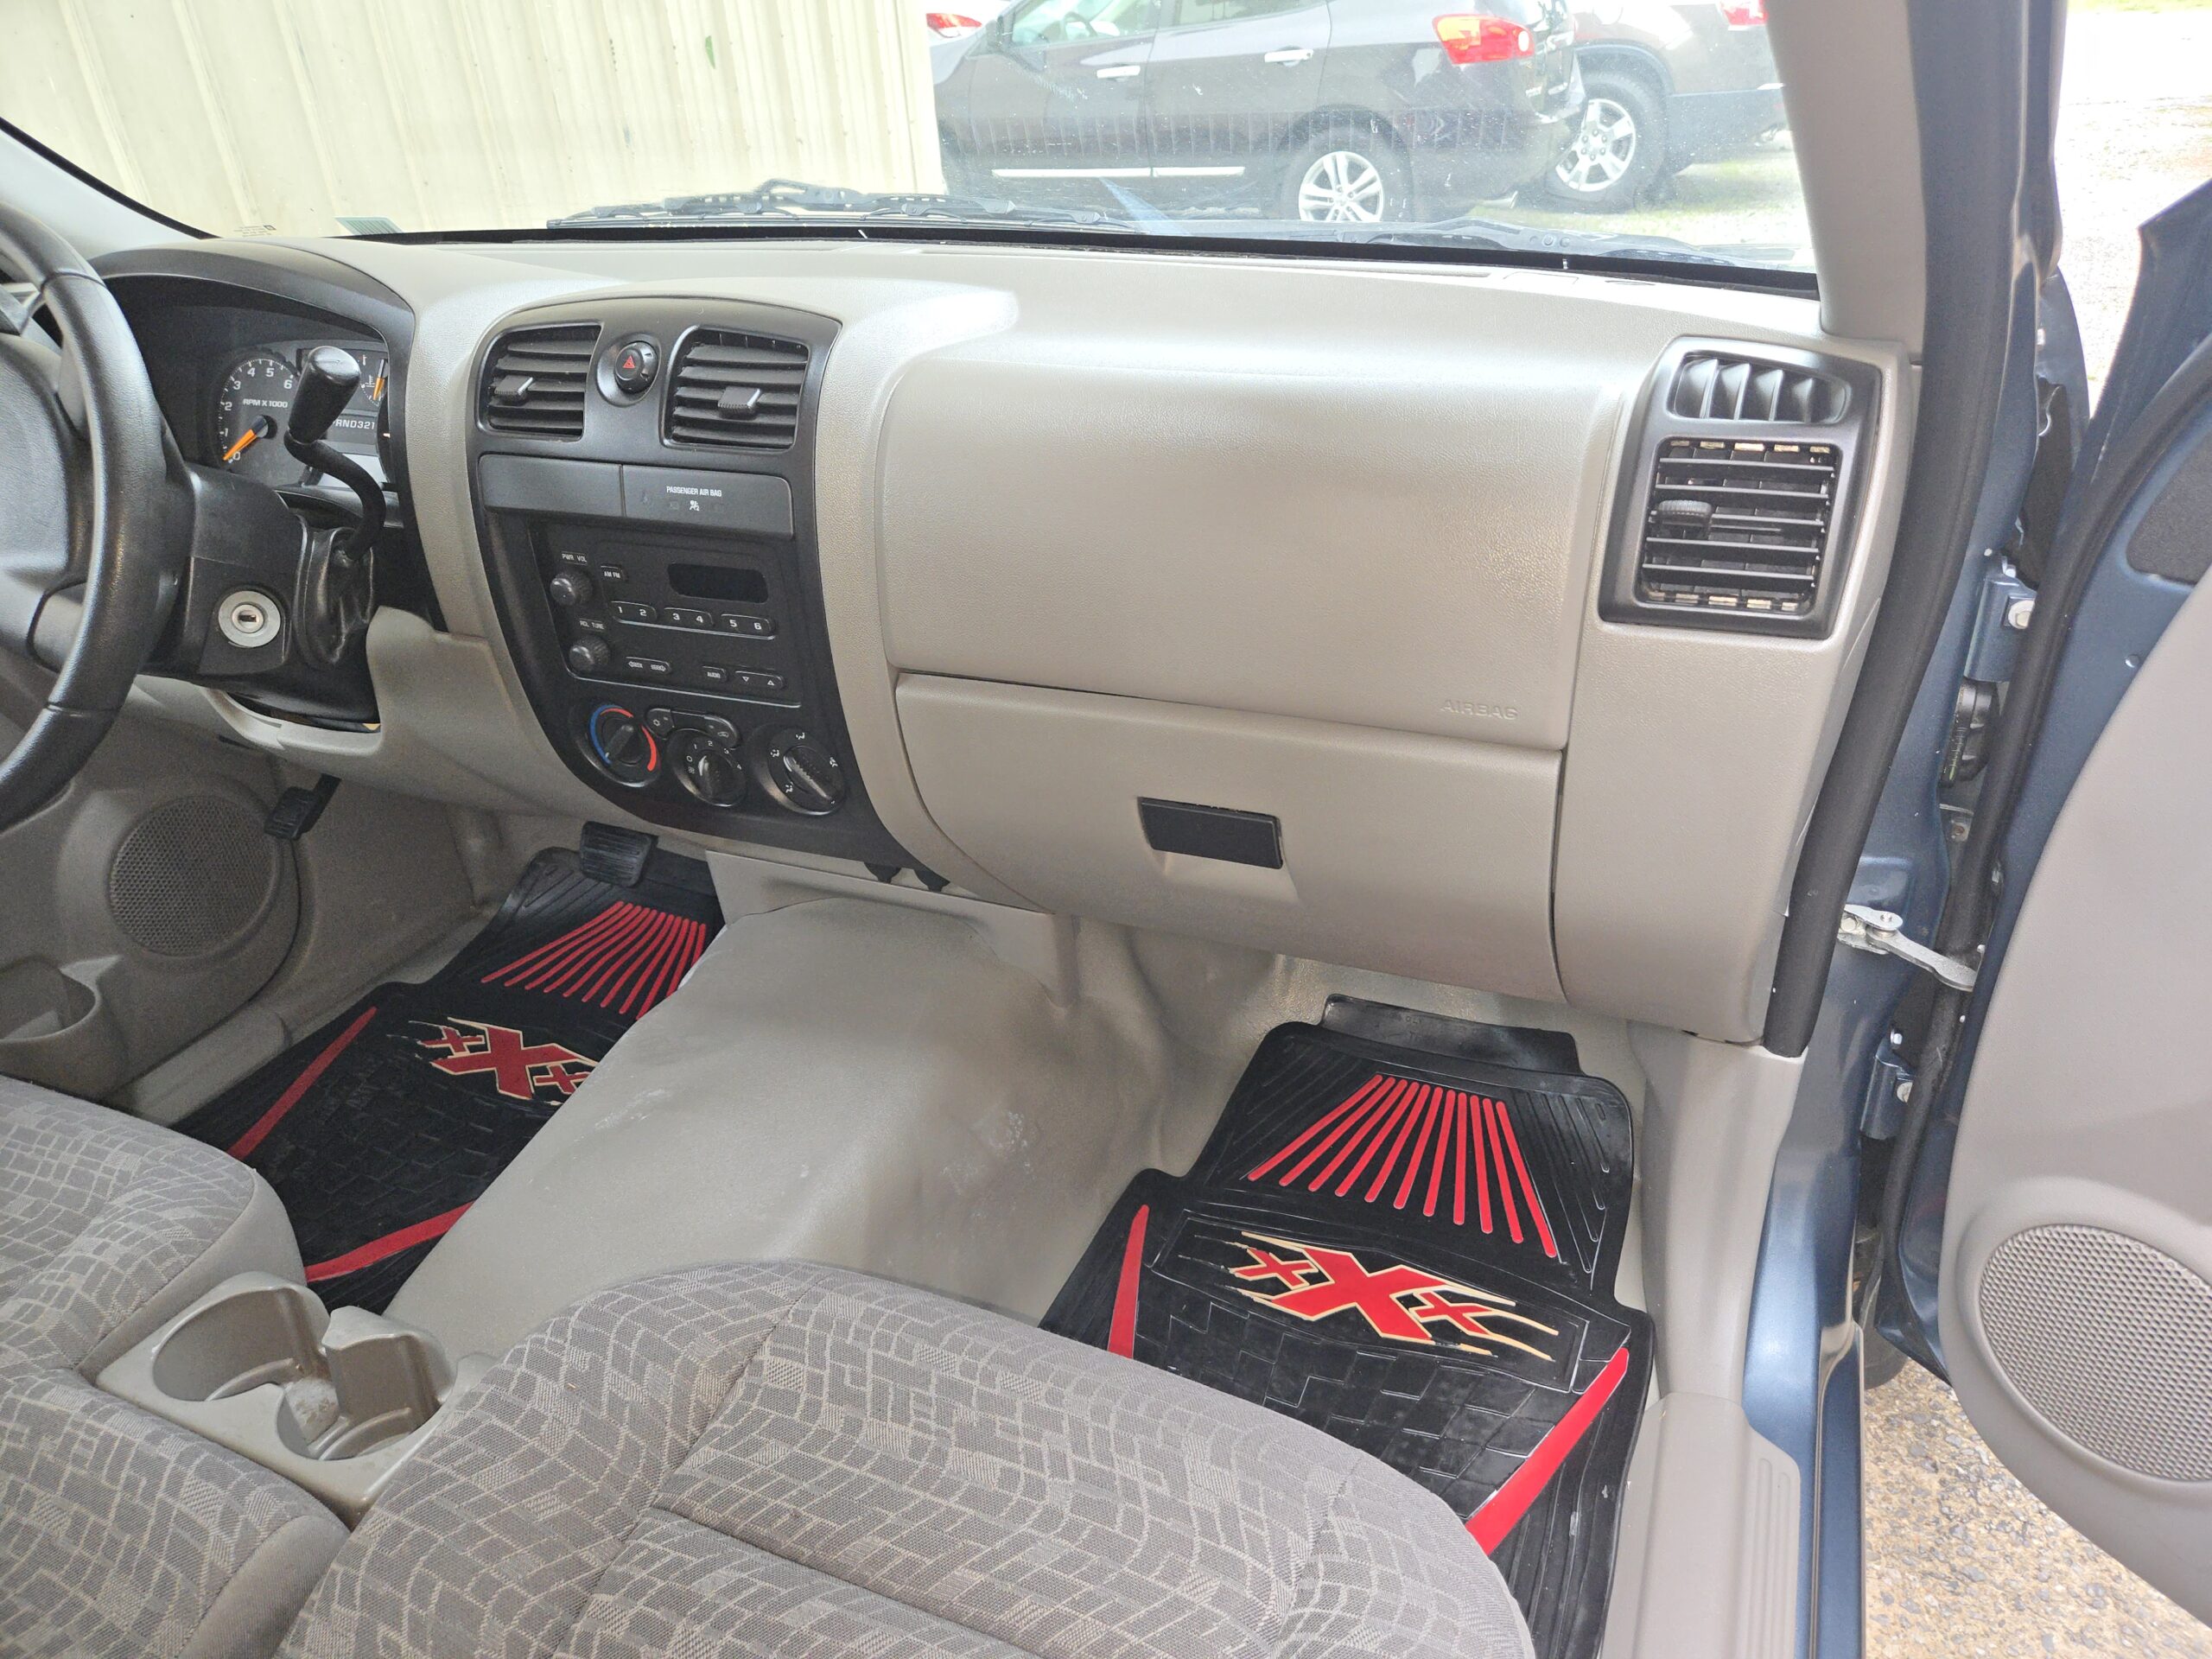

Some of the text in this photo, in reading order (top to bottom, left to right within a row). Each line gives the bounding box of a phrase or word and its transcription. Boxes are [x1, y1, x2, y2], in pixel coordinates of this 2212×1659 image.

[247, 367, 256, 377] 4
[265, 367, 275, 377] 5
[232, 380, 241, 391] 3
[283, 379, 293, 390] 6
[224, 402, 232, 411] 2
[232, 451, 241, 461] 0
[666, 486, 722, 498] PASSENGER AIR BAG
[639, 608, 647, 617] 2
[672, 613, 680, 621] 3
[729, 619, 737, 627] 5
[753, 622, 762, 631] 6
[1440, 700, 1518, 720] AIRBAG
